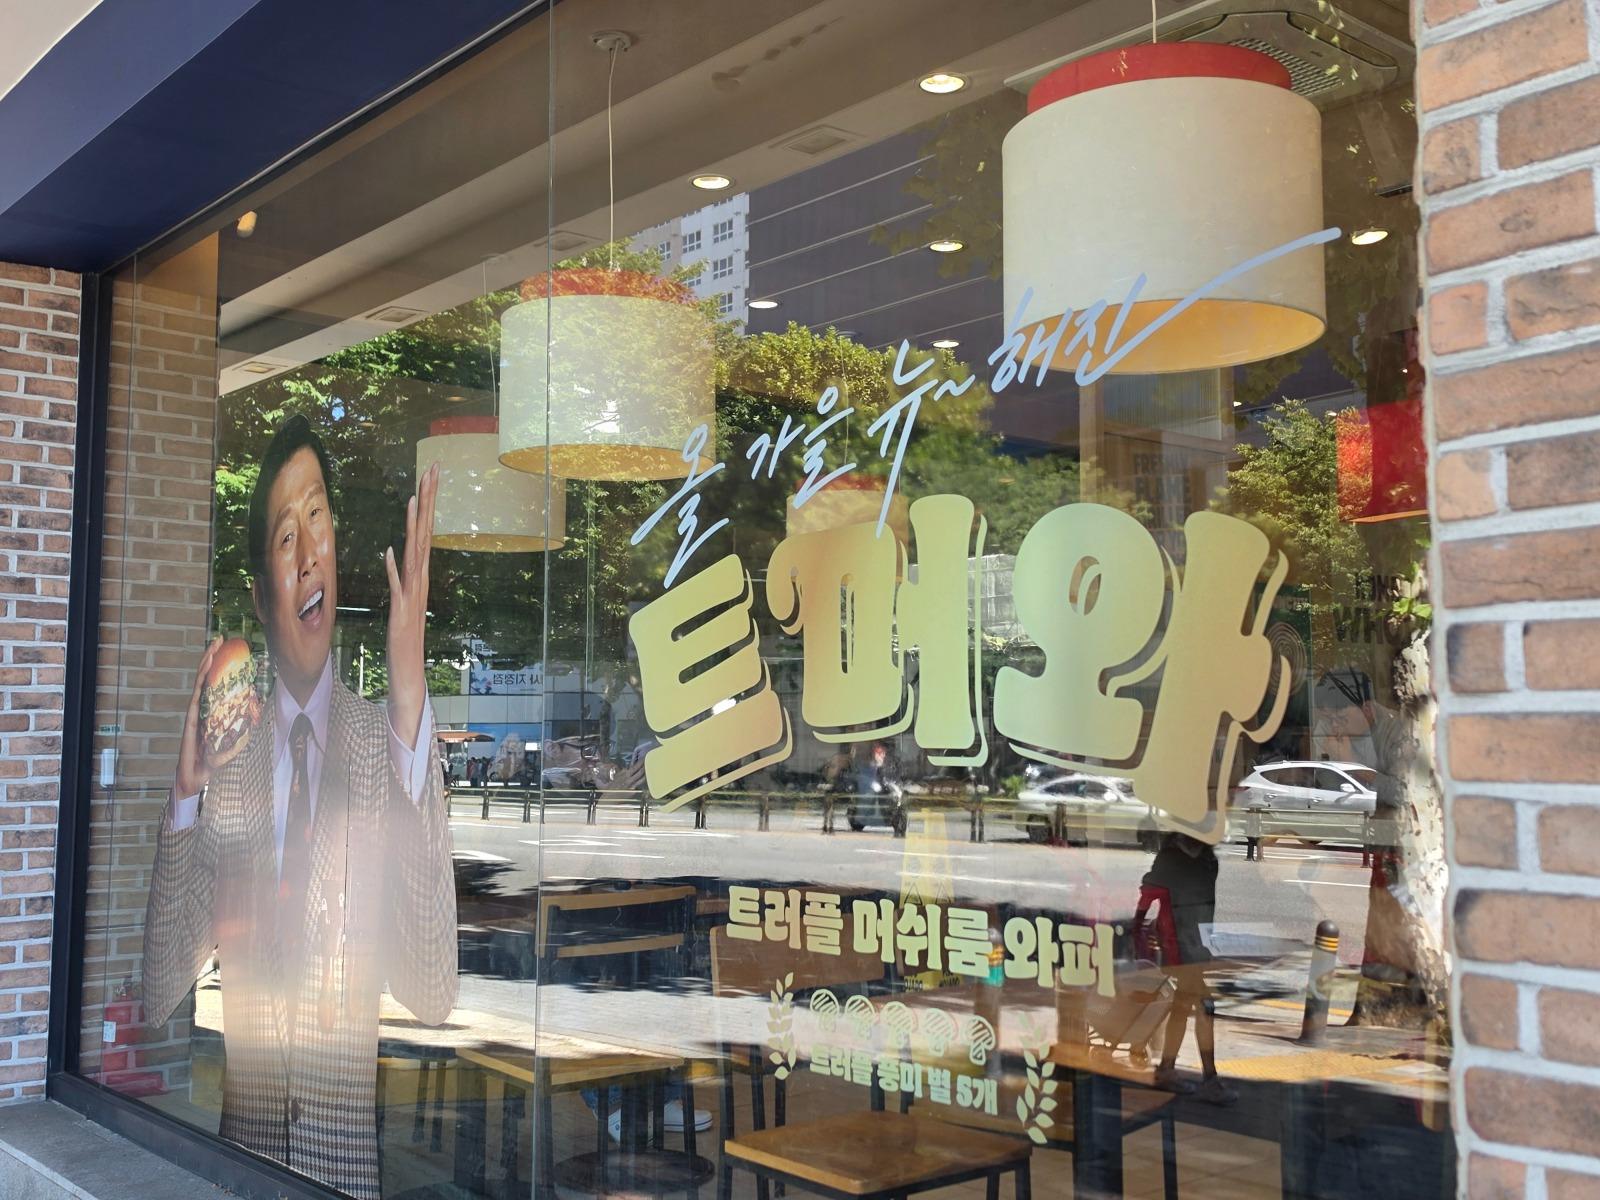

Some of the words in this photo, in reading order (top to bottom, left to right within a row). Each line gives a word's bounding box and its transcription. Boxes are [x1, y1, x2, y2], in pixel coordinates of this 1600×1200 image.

[630, 424, 733, 590] 올
[746, 385, 857, 509] 가을
[726, 885, 844, 956] 트러플
[852, 898, 995, 977] 머쉬룸
[809, 1043, 873, 1087] 트러플
[877, 1053, 924, 1099] 풍미
[927, 1067, 952, 1106] 별
[956, 1074, 999, 1116] 5개
